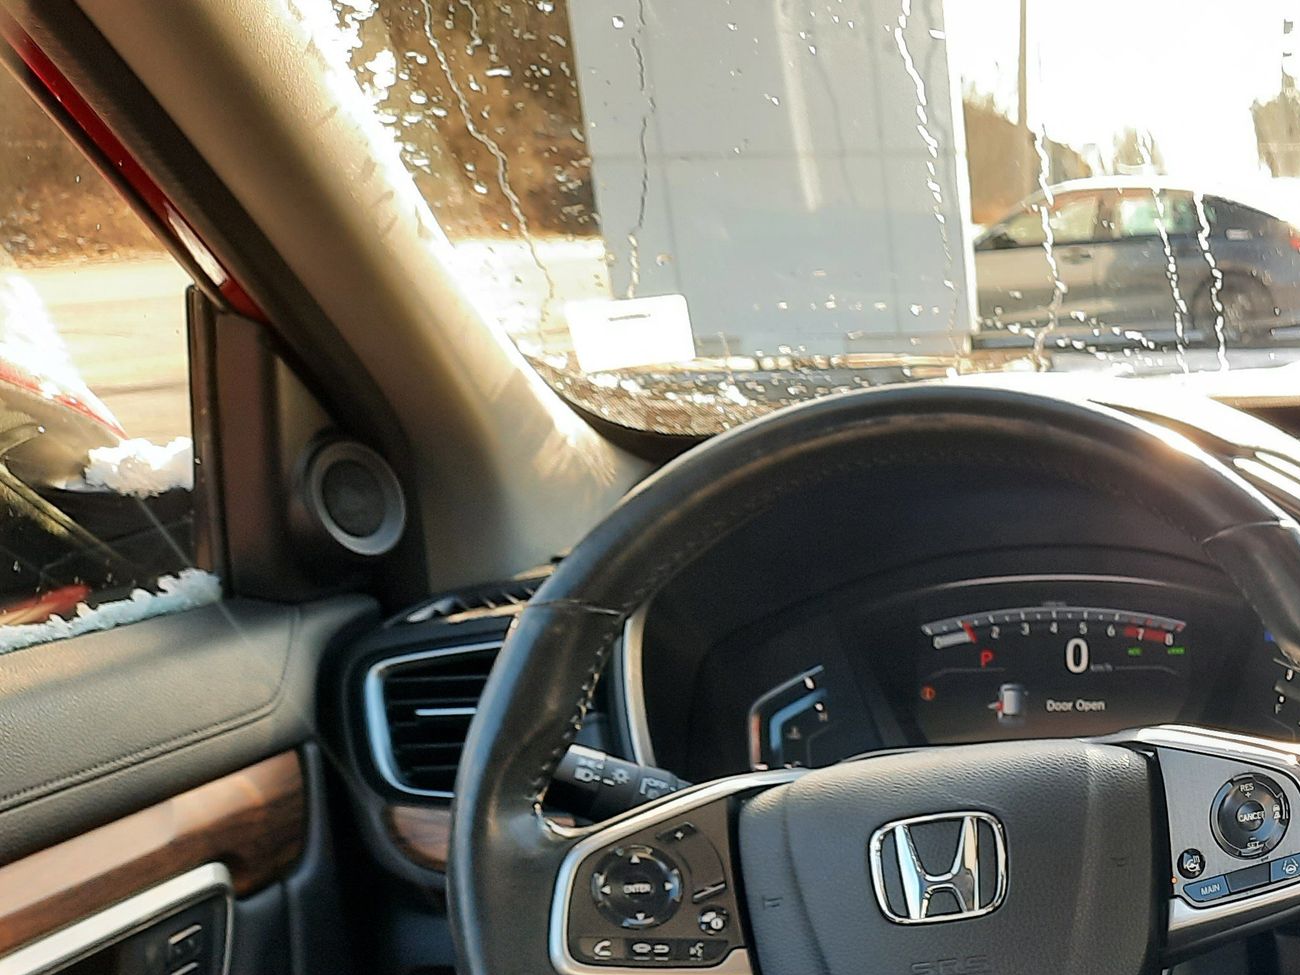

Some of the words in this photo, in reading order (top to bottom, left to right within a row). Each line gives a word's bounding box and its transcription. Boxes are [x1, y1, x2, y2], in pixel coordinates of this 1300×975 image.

[1107, 624, 1116, 637] 6
[1136, 627, 1145, 640] 7
[981, 650, 993, 667] P
[1065, 637, 1089, 673] 0
[1046, 699, 1073, 712] Door
[1075, 699, 1105, 713] Open
[1240, 783, 1254, 791] RES
[1201, 884, 1221, 896] MAIN
